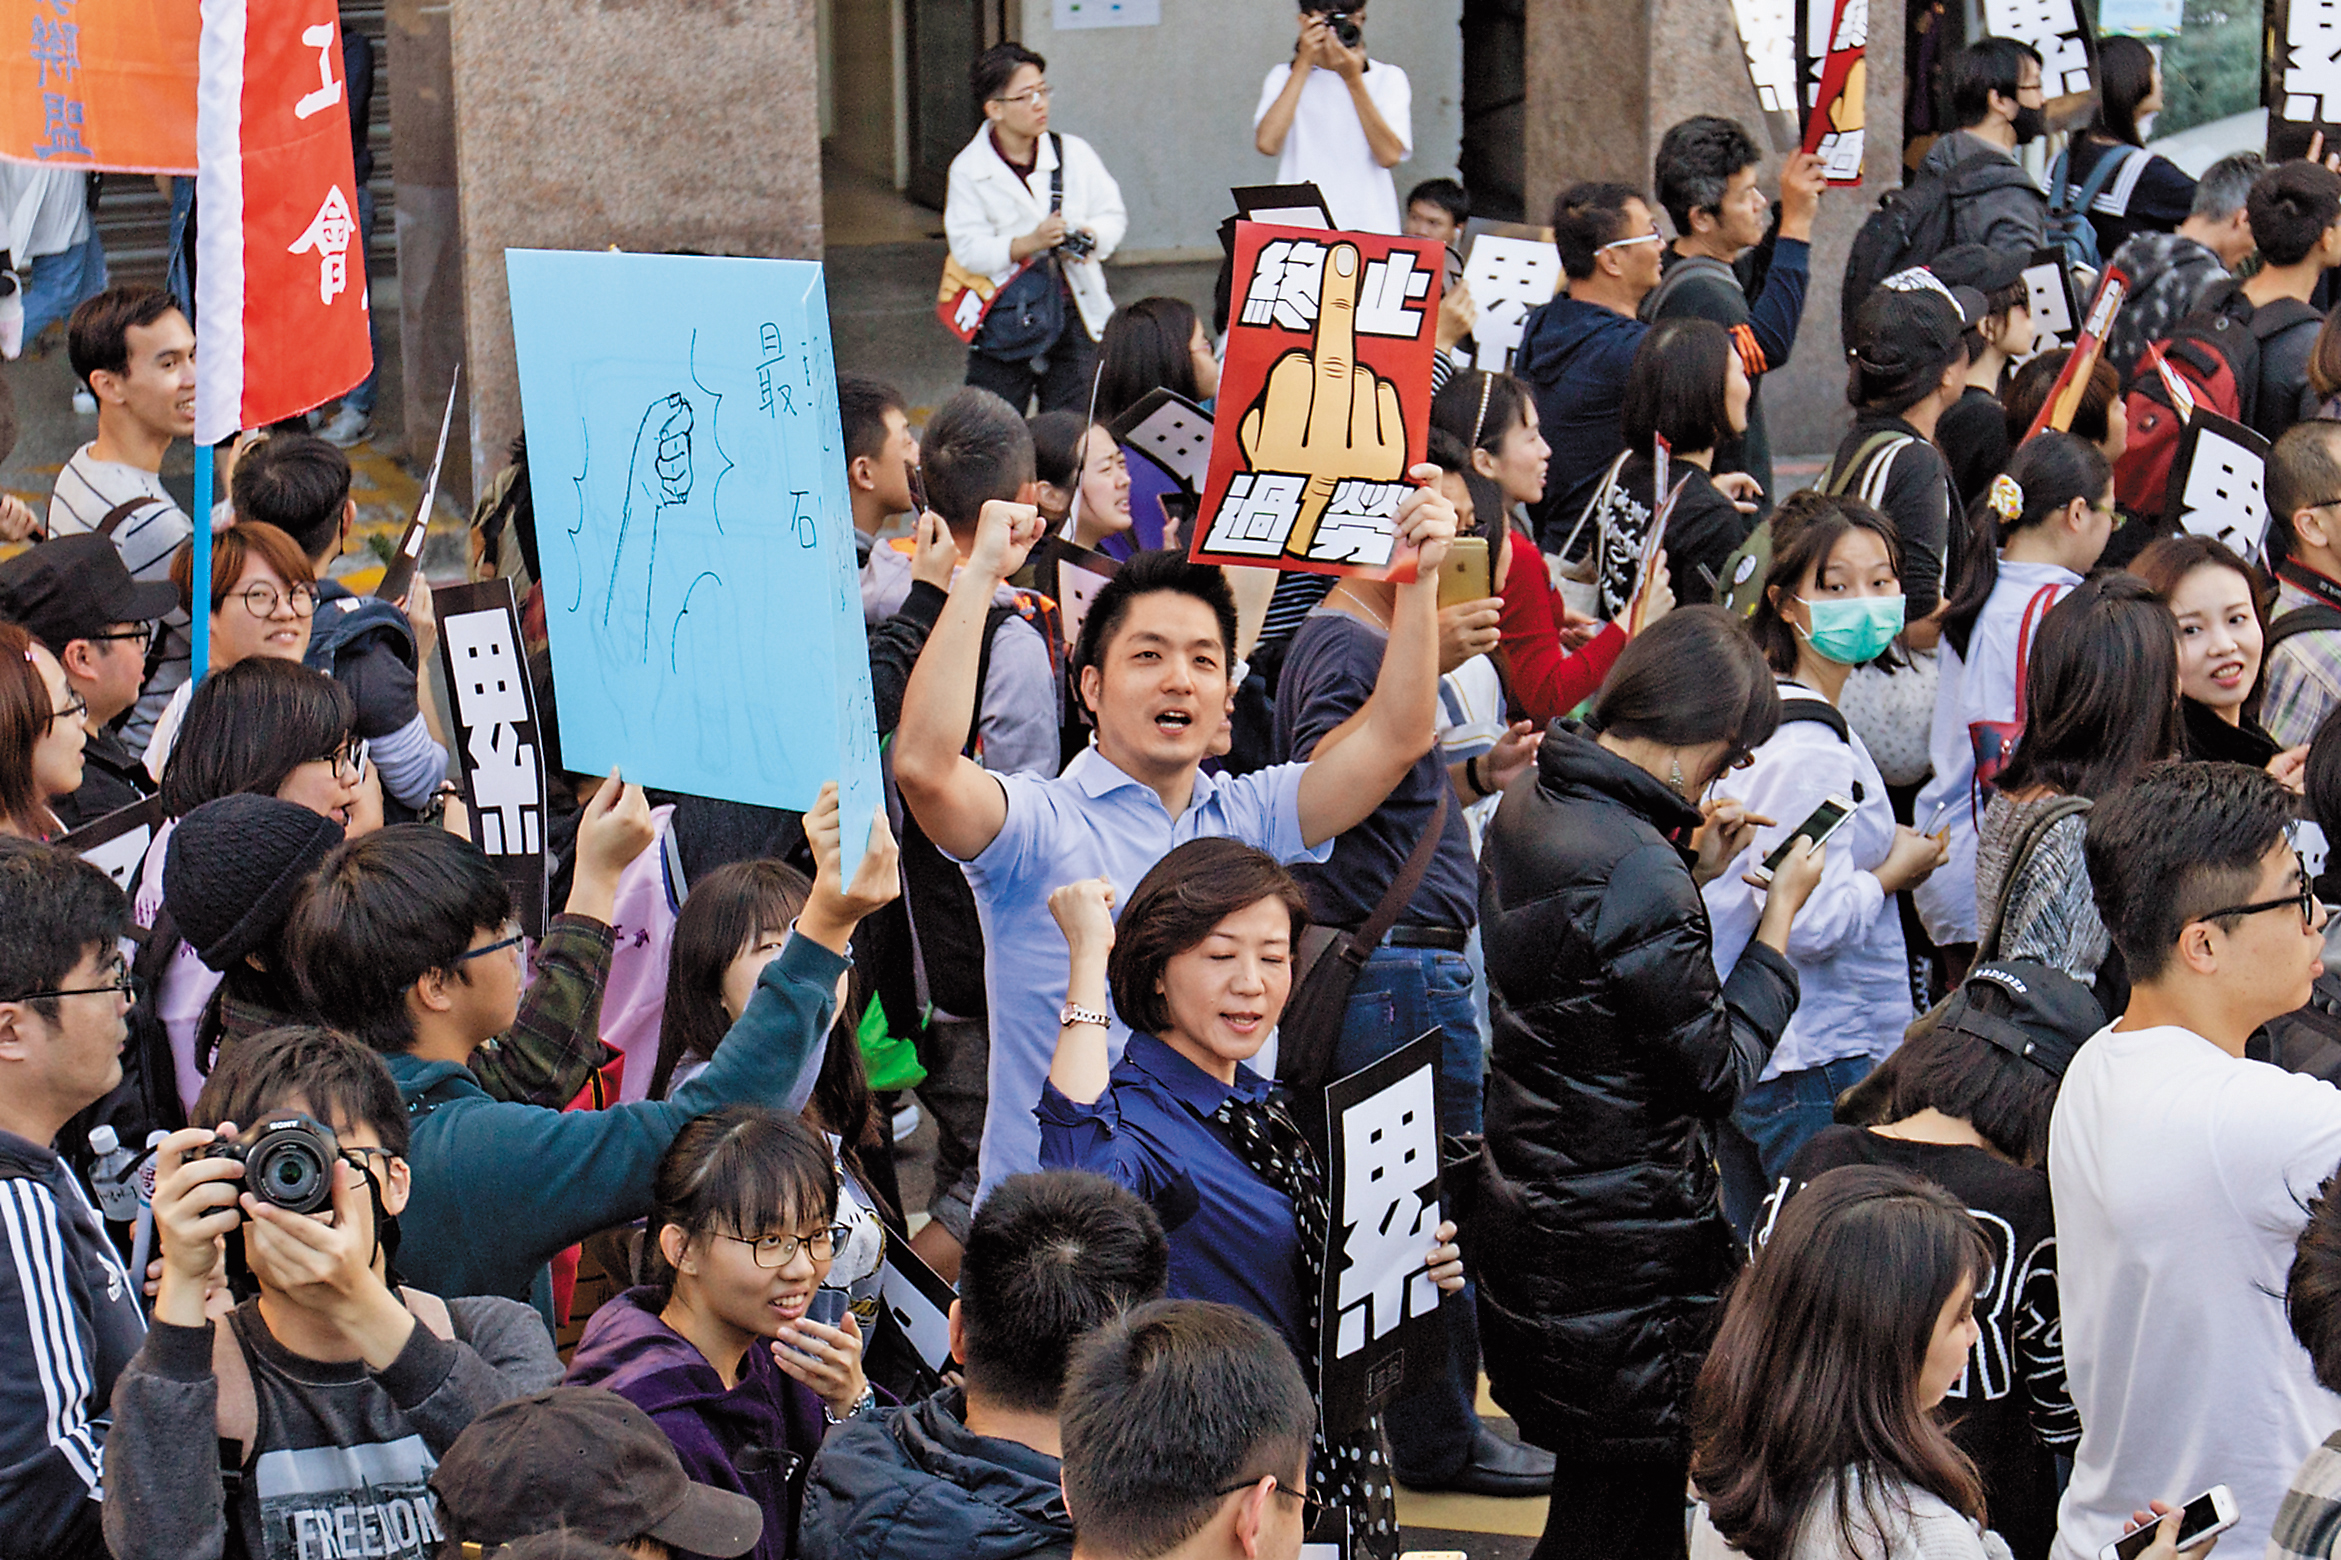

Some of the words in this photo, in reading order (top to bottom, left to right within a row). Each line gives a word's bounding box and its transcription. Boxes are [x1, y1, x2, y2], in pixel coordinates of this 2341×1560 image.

[288, 21, 356, 306] 工會
[1241, 240, 1430, 338] 終止
[1203, 473, 1416, 565] 過勞
[444, 607, 540, 855] 累
[269, 1120, 299, 1130] SONY
[1336, 1062, 1440, 1361] 累
